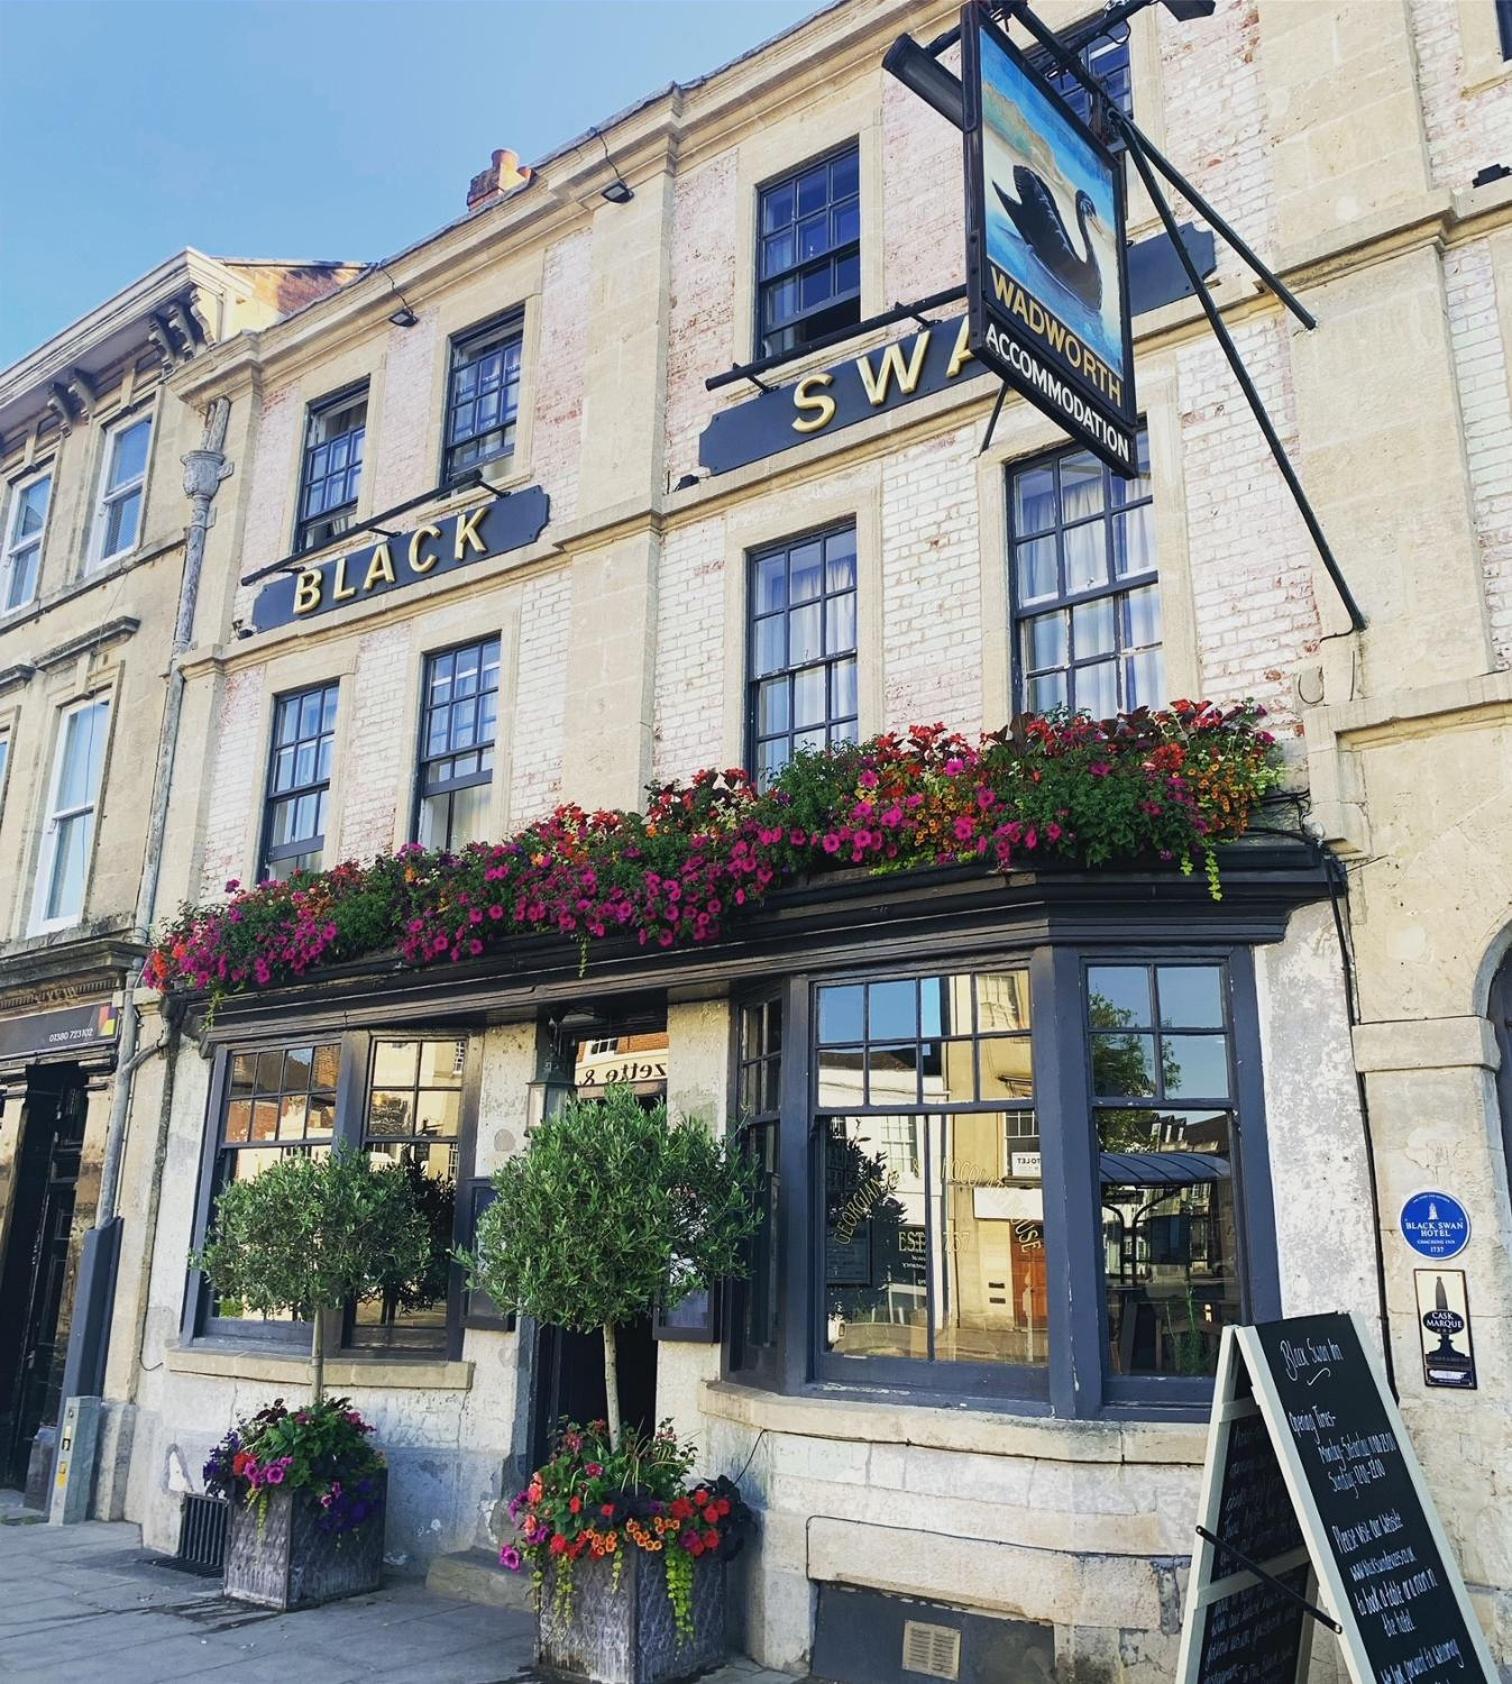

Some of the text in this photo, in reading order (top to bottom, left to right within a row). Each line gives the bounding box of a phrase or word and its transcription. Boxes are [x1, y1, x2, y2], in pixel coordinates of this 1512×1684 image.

[991, 265, 1122, 408] WADWORTH
[792, 315, 974, 433] SWA
[985, 322, 1130, 462] ACCOMMODATION
[293, 506, 488, 614] BLACK
[833, 1176, 884, 1246] GEORGIAN
[1009, 1214, 1042, 1253] OUSE
[1405, 1221, 1464, 1230] BLACK SWAN
[1420, 1229, 1451, 1237] HOTEL
[1426, 1319, 1463, 1329] MARQUE
[1431, 1311, 1455, 1320] CASK
[1280, 1339, 1310, 1381] Black
[1306, 1337, 1331, 1364] Swan
[1289, 1409, 1321, 1445] Opening
[1331, 1525, 1360, 1555] Please
[1361, 1585, 1384, 1615] book
